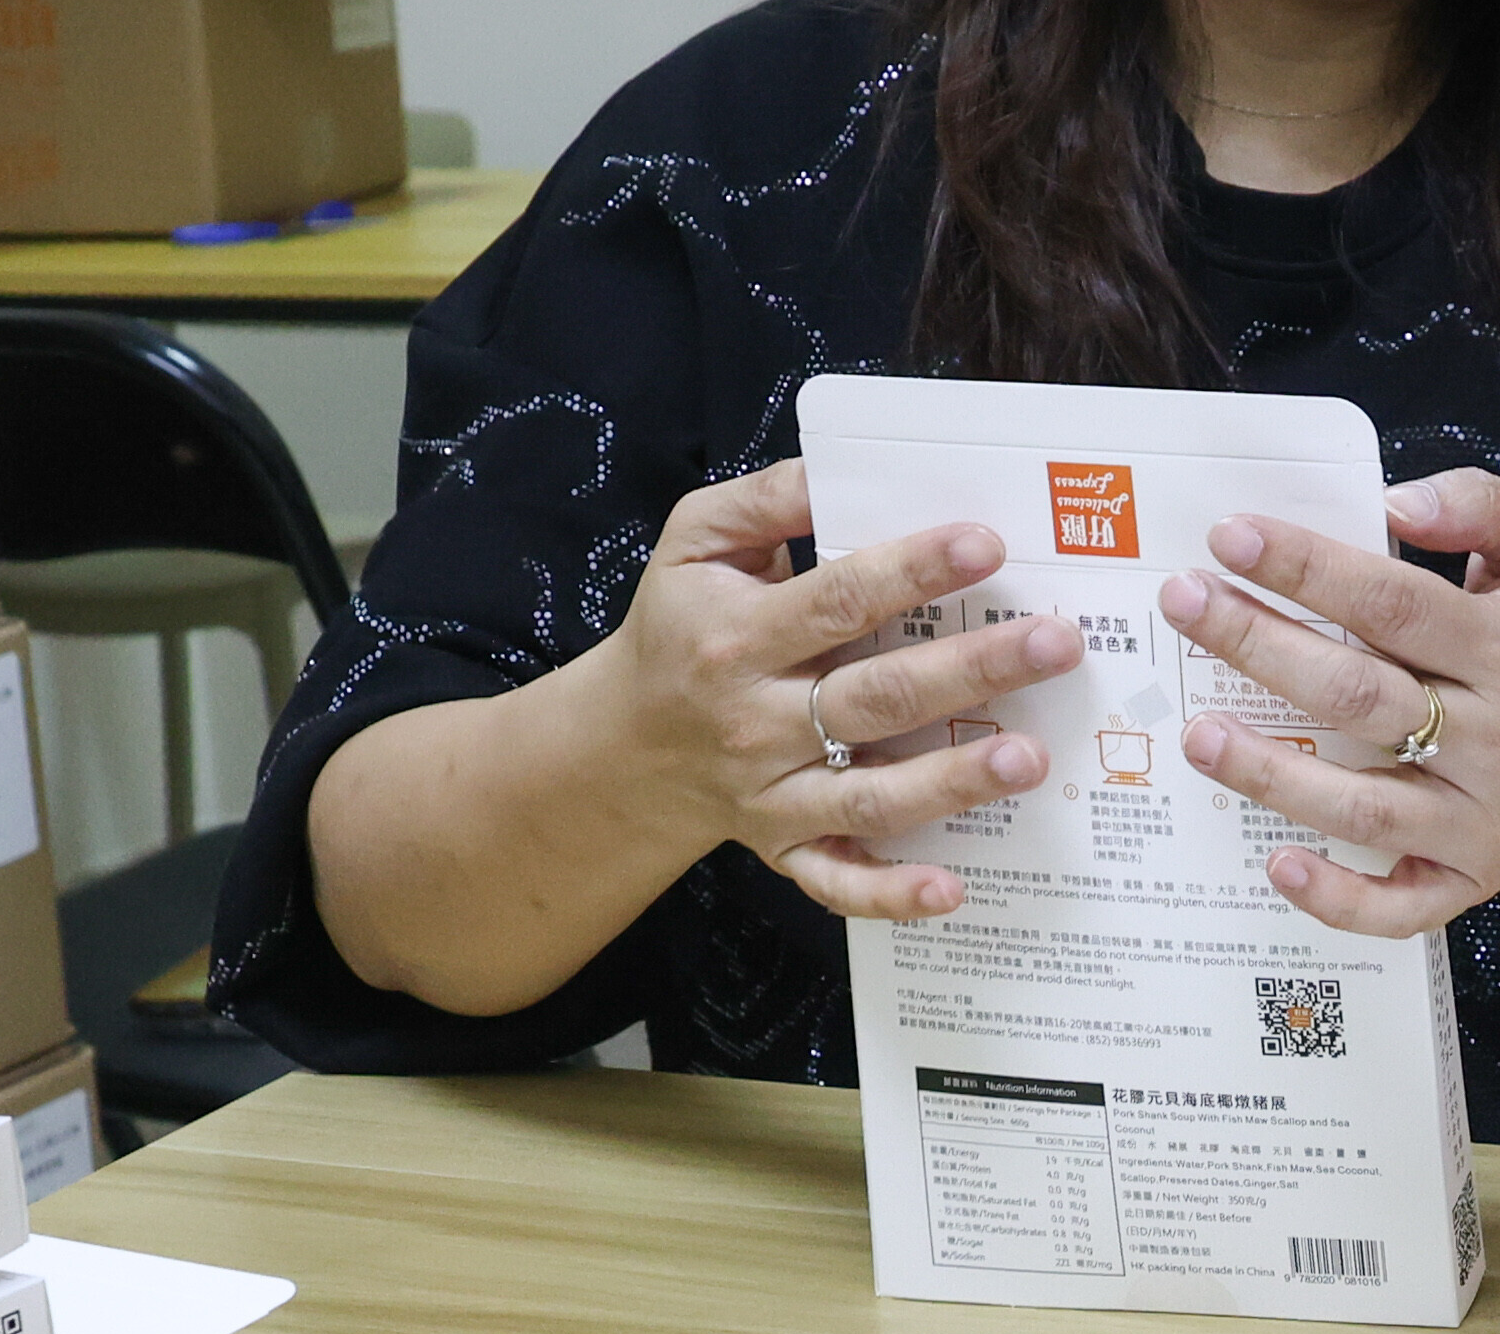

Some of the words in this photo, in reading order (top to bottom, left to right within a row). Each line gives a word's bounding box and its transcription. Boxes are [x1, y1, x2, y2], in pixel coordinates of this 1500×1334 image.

[1055, 472, 1115, 494] Express
[1057, 493, 1129, 515] Delicious
[1078, 615, 1129, 634] 無添加
[1191, 694, 1207, 706] Do
[1209, 697, 1228, 707] not
[1231, 698, 1266, 709] reheat
[1269, 699, 1288, 709] the
[971, 895, 989, 905] tree
[1004, 884, 1031, 895] which
[1033, 887, 1080, 900] processes
[1118, 893, 1170, 907] containing
[1172, 896, 1206, 909] gluten,
[1209, 899, 1265, 911] crustacean,
[1268, 903, 1291, 914] egg,
[892, 929, 934, 944] Consume
[1061, 946, 1091, 958] Please
[1094, 948, 1107, 959] do
[1109, 951, 1126, 961] not
[1129, 953, 1173, 963] consume
[1184, 954, 1201, 965] the
[1204, 955, 1235, 968] pouch
[1237, 957, 1245, 967] is
[1248, 956, 1285, 970] broken,
[1288, 958, 1325, 973] leaking
[1328, 962, 1339, 971] or
[951, 965, 969, 976] and
[971, 966, 987, 979] dry
[989, 968, 1014, 981] place
[1016, 971, 1034, 982] and
[1036, 973, 1062, 984] avoid
[1065, 976, 1092, 987] direct
[1008, 1026, 1041, 1041] Service
[1044, 1030, 1079, 1044] Hotline
[1086, 1034, 1111, 1046] (852)
[1113, 1035, 1161, 1048] 98536993
[986, 1081, 1024, 1094] Nutrition
[1026, 1084, 1077, 1097] Information
[1112, 1089, 1287, 1111] 花膠元貝海底椰燉豬展
[1114, 1109, 1135, 1119] Pork
[1138, 1110, 1168, 1120] Shank
[1171, 1111, 1196, 1121] Soup
[1198, 1112, 1220, 1122] With
[1222, 1113, 1242, 1123] Fish
[1246, 1114, 1268, 1124] Maw
[1271, 1115, 1307, 1126] Scallop
[1310, 1117, 1328, 1127] and
[1331, 1117, 1350, 1127] Sea
[1115, 1124, 1155, 1135] Coconut
[1162, 1192, 1181, 1204] Net
[1184, 1193, 1218, 1206] Weight
[1196, 1211, 1216, 1222] Best
[1219, 1212, 1251, 1224] Before
[1131, 1262, 1144, 1272] HK
[1148, 1262, 1185, 1273] packing
[1188, 1264, 1202, 1274] for
[1205, 1265, 1232, 1275] made
[1235, 1266, 1244, 1276] in
[1246, 1267, 1275, 1277] China
[1284, 1273, 1290, 1283] 9
[1300, 1275, 1335, 1285] 782020
[1344, 1277, 1381, 1287] 081016
